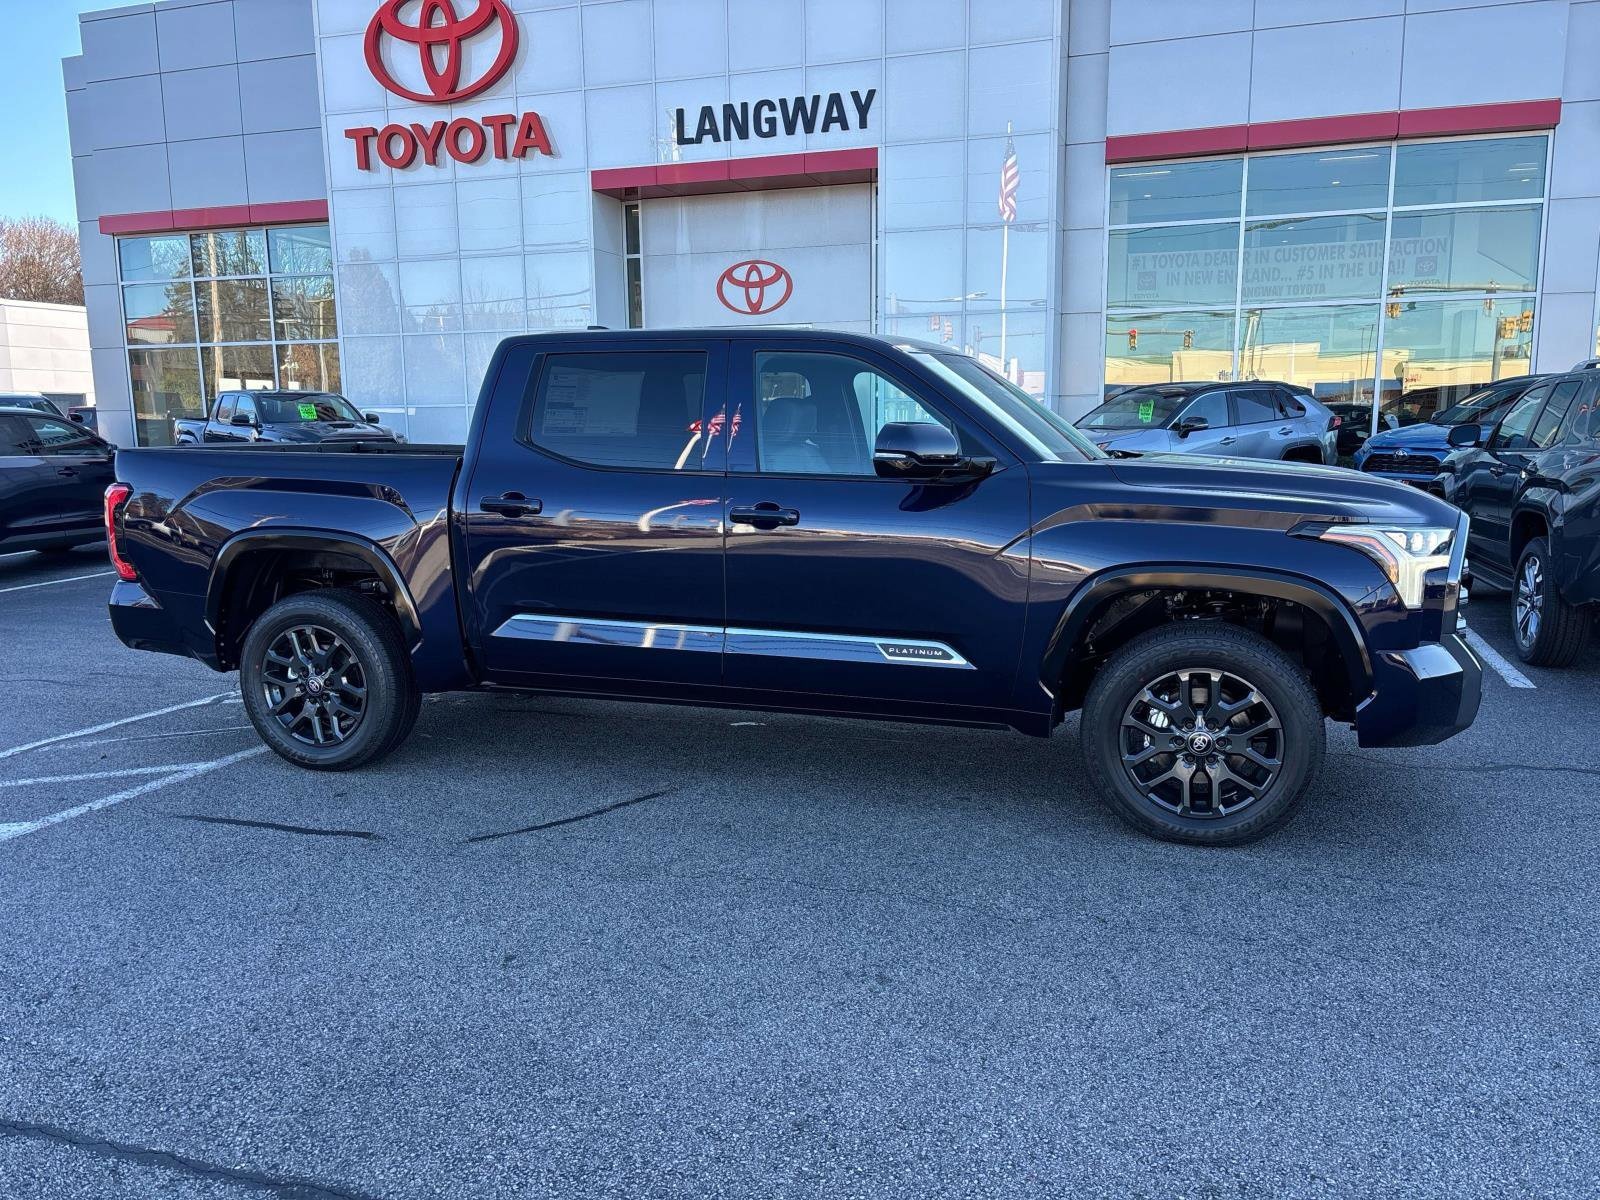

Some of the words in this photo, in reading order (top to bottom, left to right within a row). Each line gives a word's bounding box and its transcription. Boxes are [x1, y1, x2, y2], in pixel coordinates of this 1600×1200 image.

[675, 89, 876, 145] LANGWAY
[344, 111, 553, 171] TOYOTA
[1132, 255, 1147, 271] #1
[1152, 253, 1200, 269] TOYOTA
[1204, 249, 1250, 267] DEALR
[1255, 249, 1270, 264] IN
[1276, 244, 1345, 264] CUSTOMER
[1166, 271, 1180, 287] IN
[1185, 269, 1214, 286] NEW
[1218, 267, 1292, 286] ENLAND...
[1296, 264, 1315, 281] #5
[1319, 263, 1334, 280] IN
[1338, 262, 1365, 279] THE
[1241, 286, 1284, 298] ANGWAY
[1287, 283, 1326, 296] TOYOTA
[888, 647, 942, 656] PLATINUM
